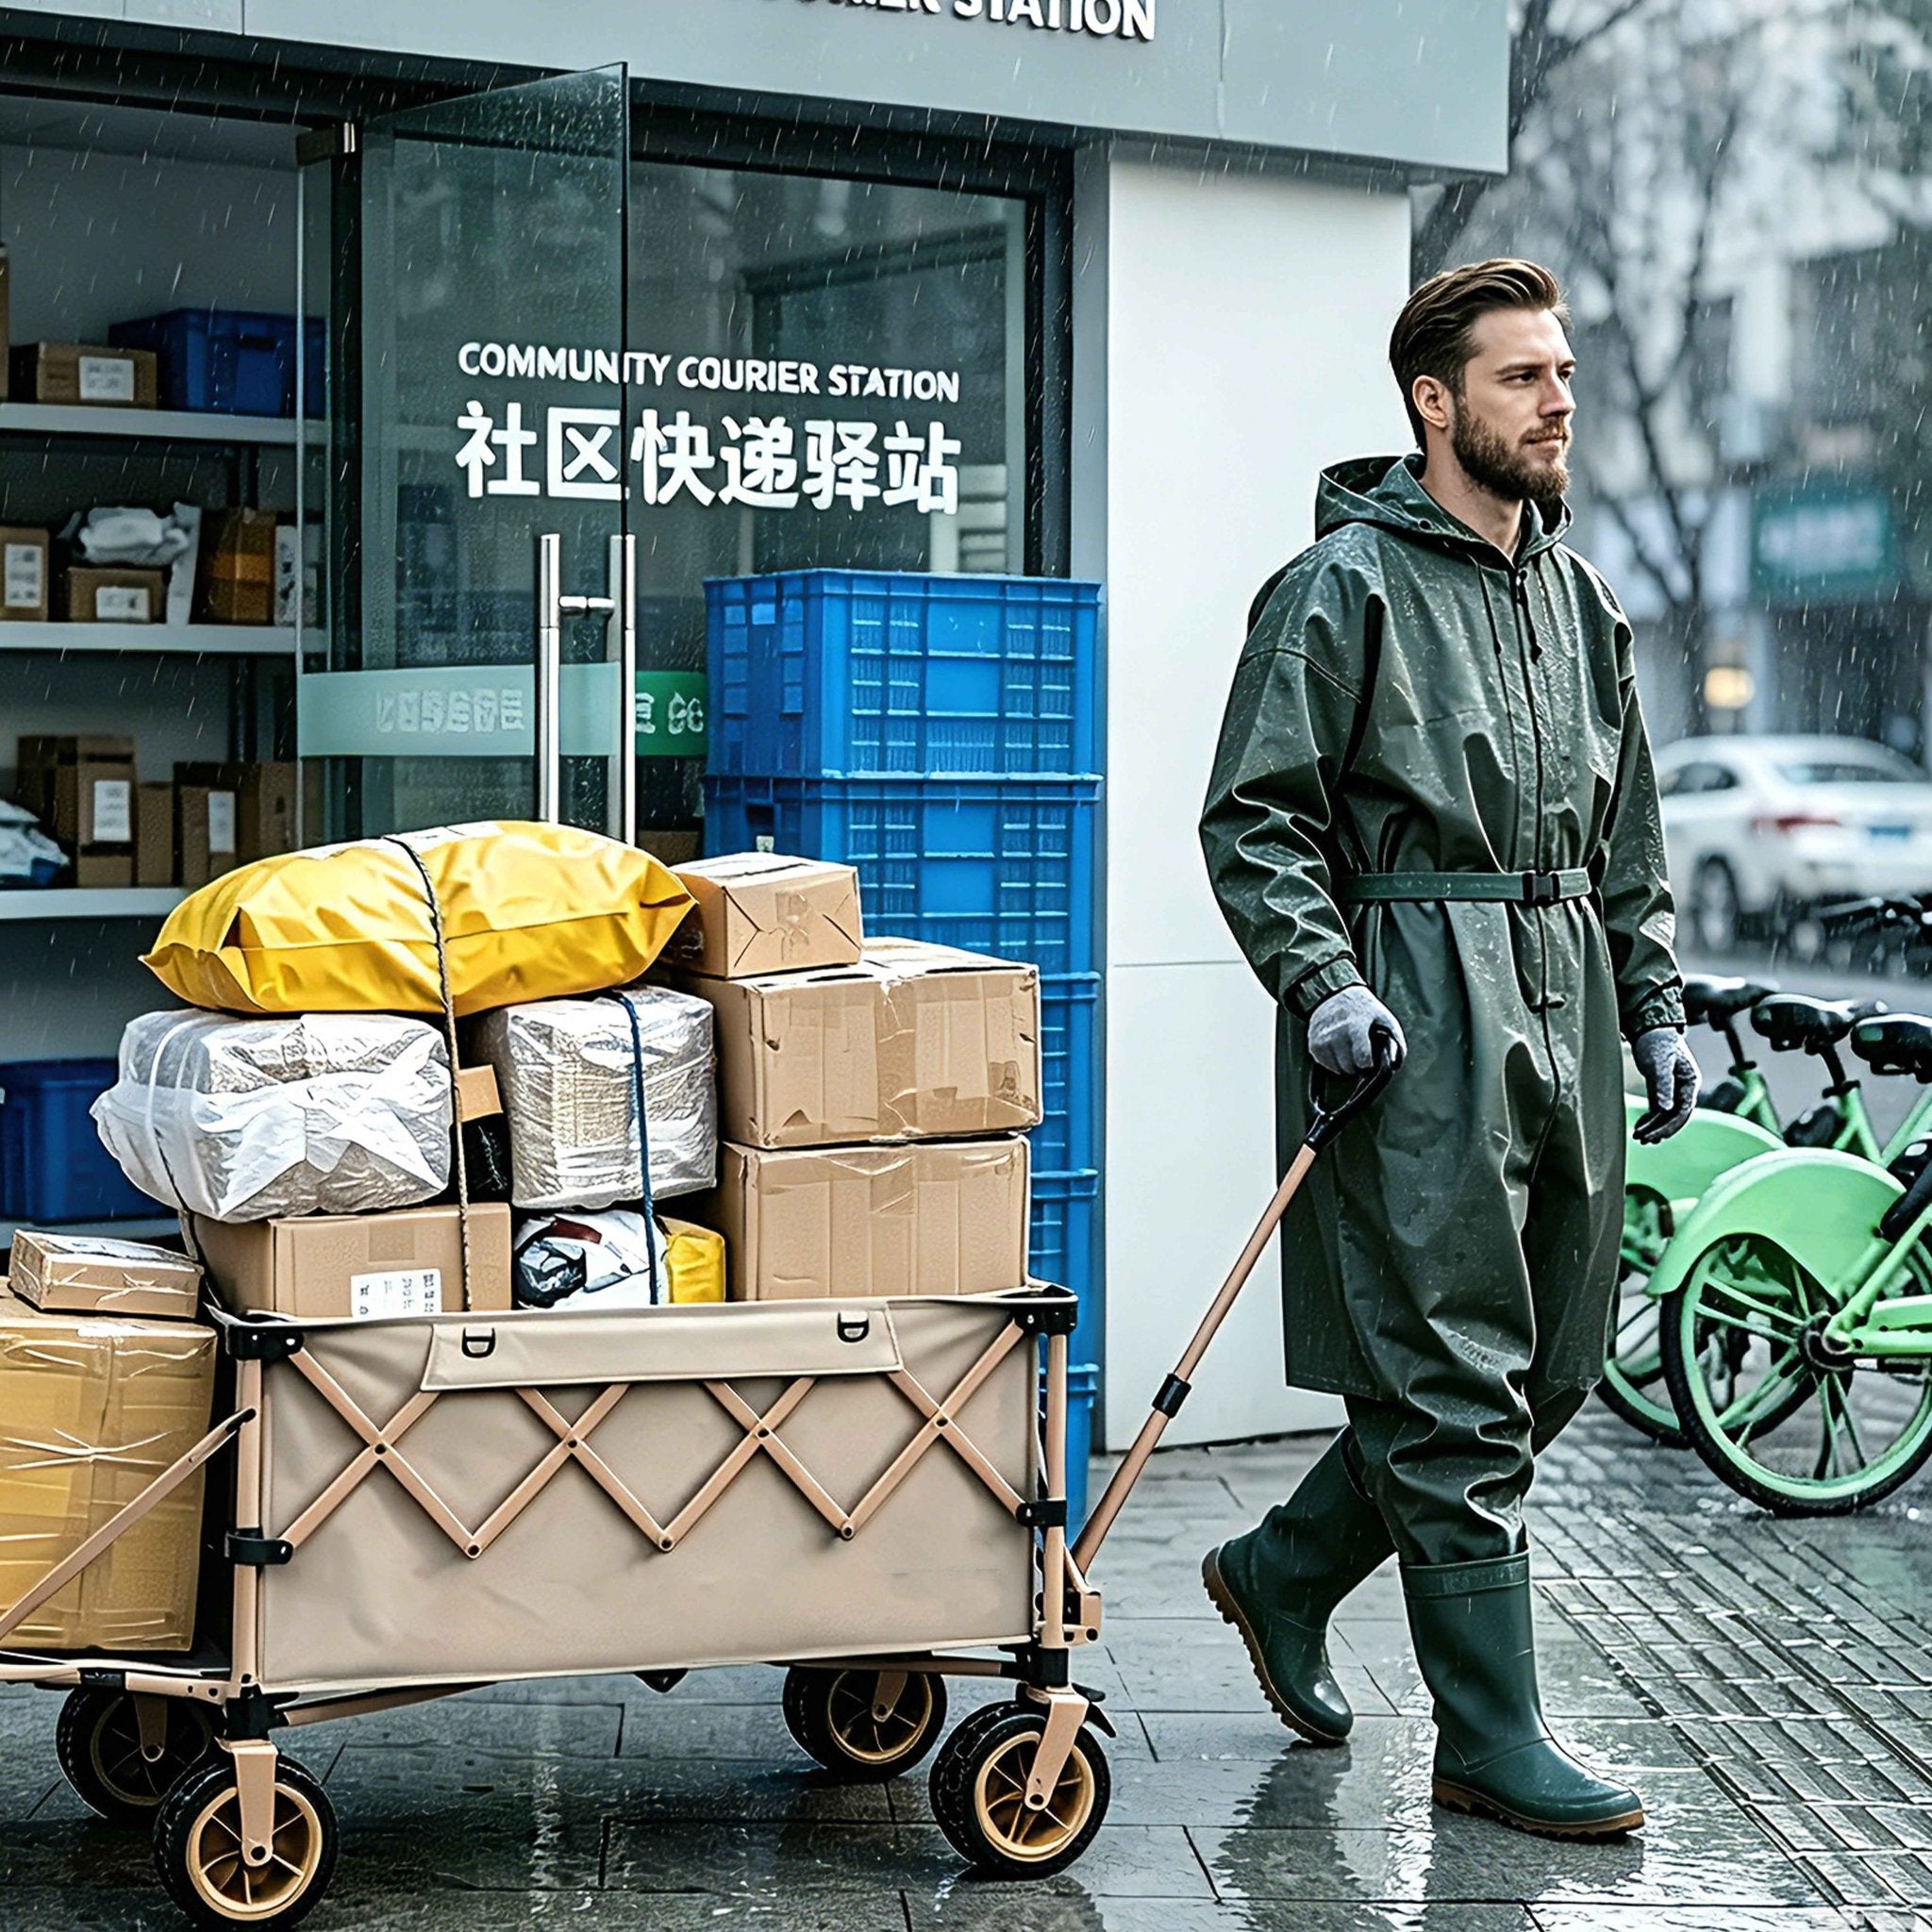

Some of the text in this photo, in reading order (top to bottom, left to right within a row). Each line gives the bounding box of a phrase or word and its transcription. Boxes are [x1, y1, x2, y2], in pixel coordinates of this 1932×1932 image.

[458, 341, 959, 403] COMMUNITY COURIER STATION
[455, 400, 962, 515] 社区快递驿站
